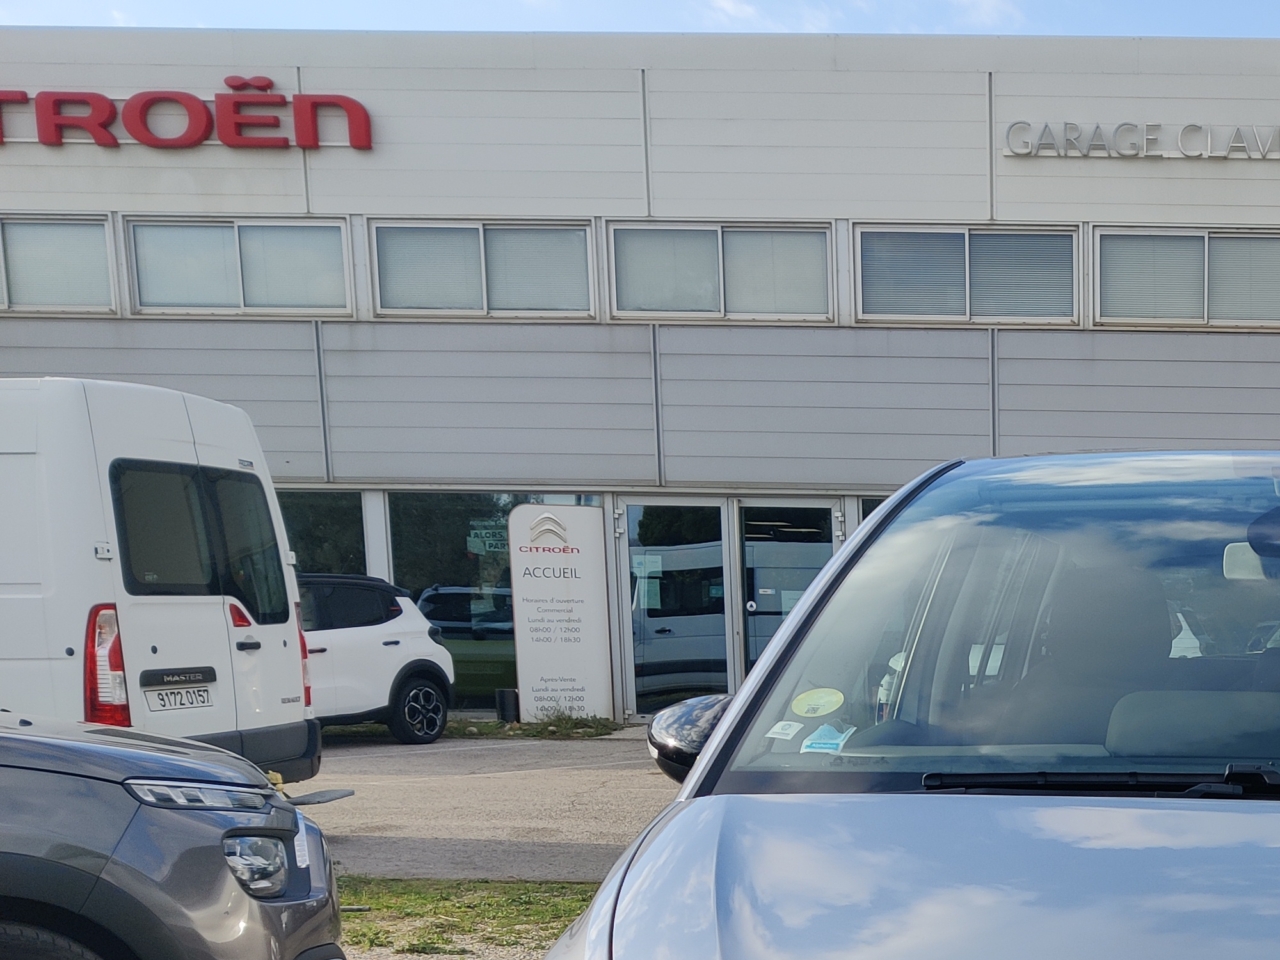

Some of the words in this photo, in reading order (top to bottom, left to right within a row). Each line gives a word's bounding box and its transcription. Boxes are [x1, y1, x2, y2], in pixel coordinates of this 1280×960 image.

[1005, 121, 1163, 157] GARAGE
[522, 566, 582, 579] ACCUEIL
[163, 673, 203, 683] MASTER
